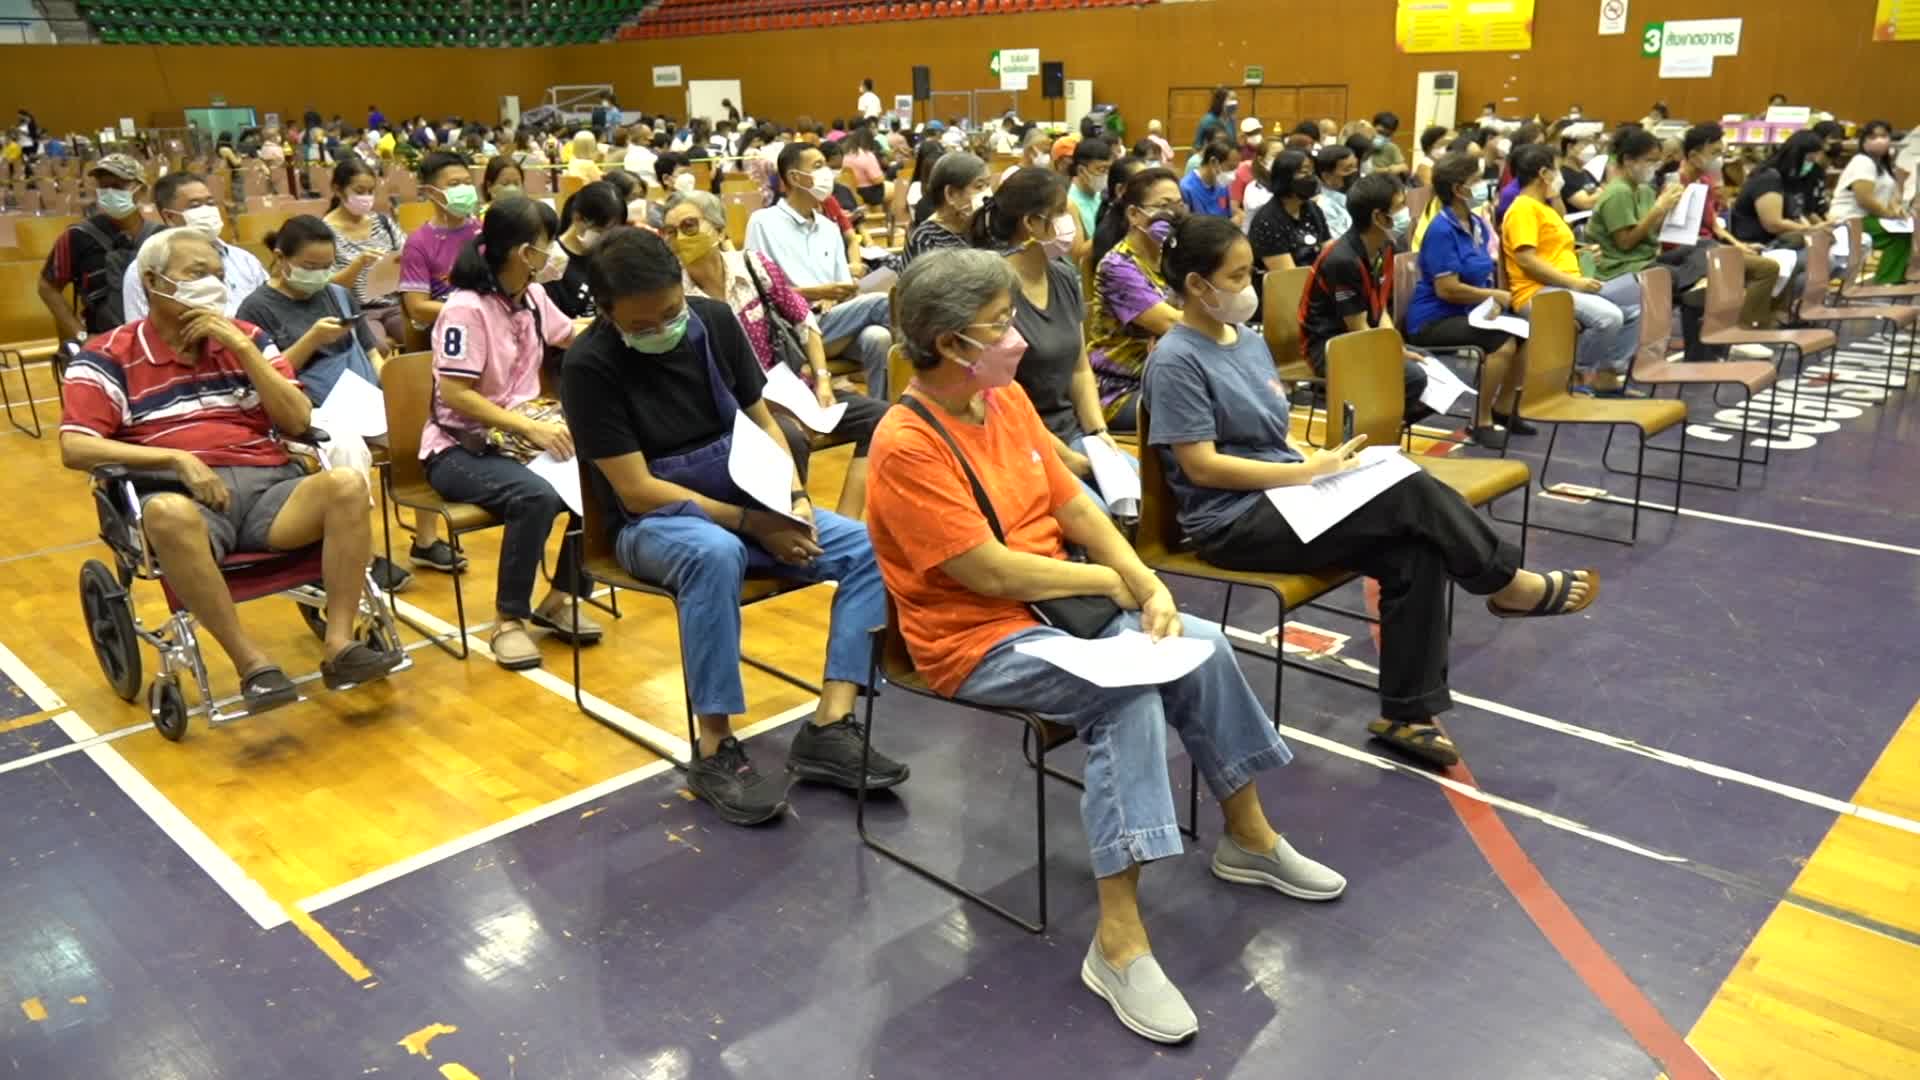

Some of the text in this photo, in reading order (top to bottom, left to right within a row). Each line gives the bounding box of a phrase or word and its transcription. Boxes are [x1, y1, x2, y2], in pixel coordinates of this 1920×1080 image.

[1643, 28, 1661, 53] 3
[991, 55, 1000, 73] 4
[444, 327, 462, 356] 8
